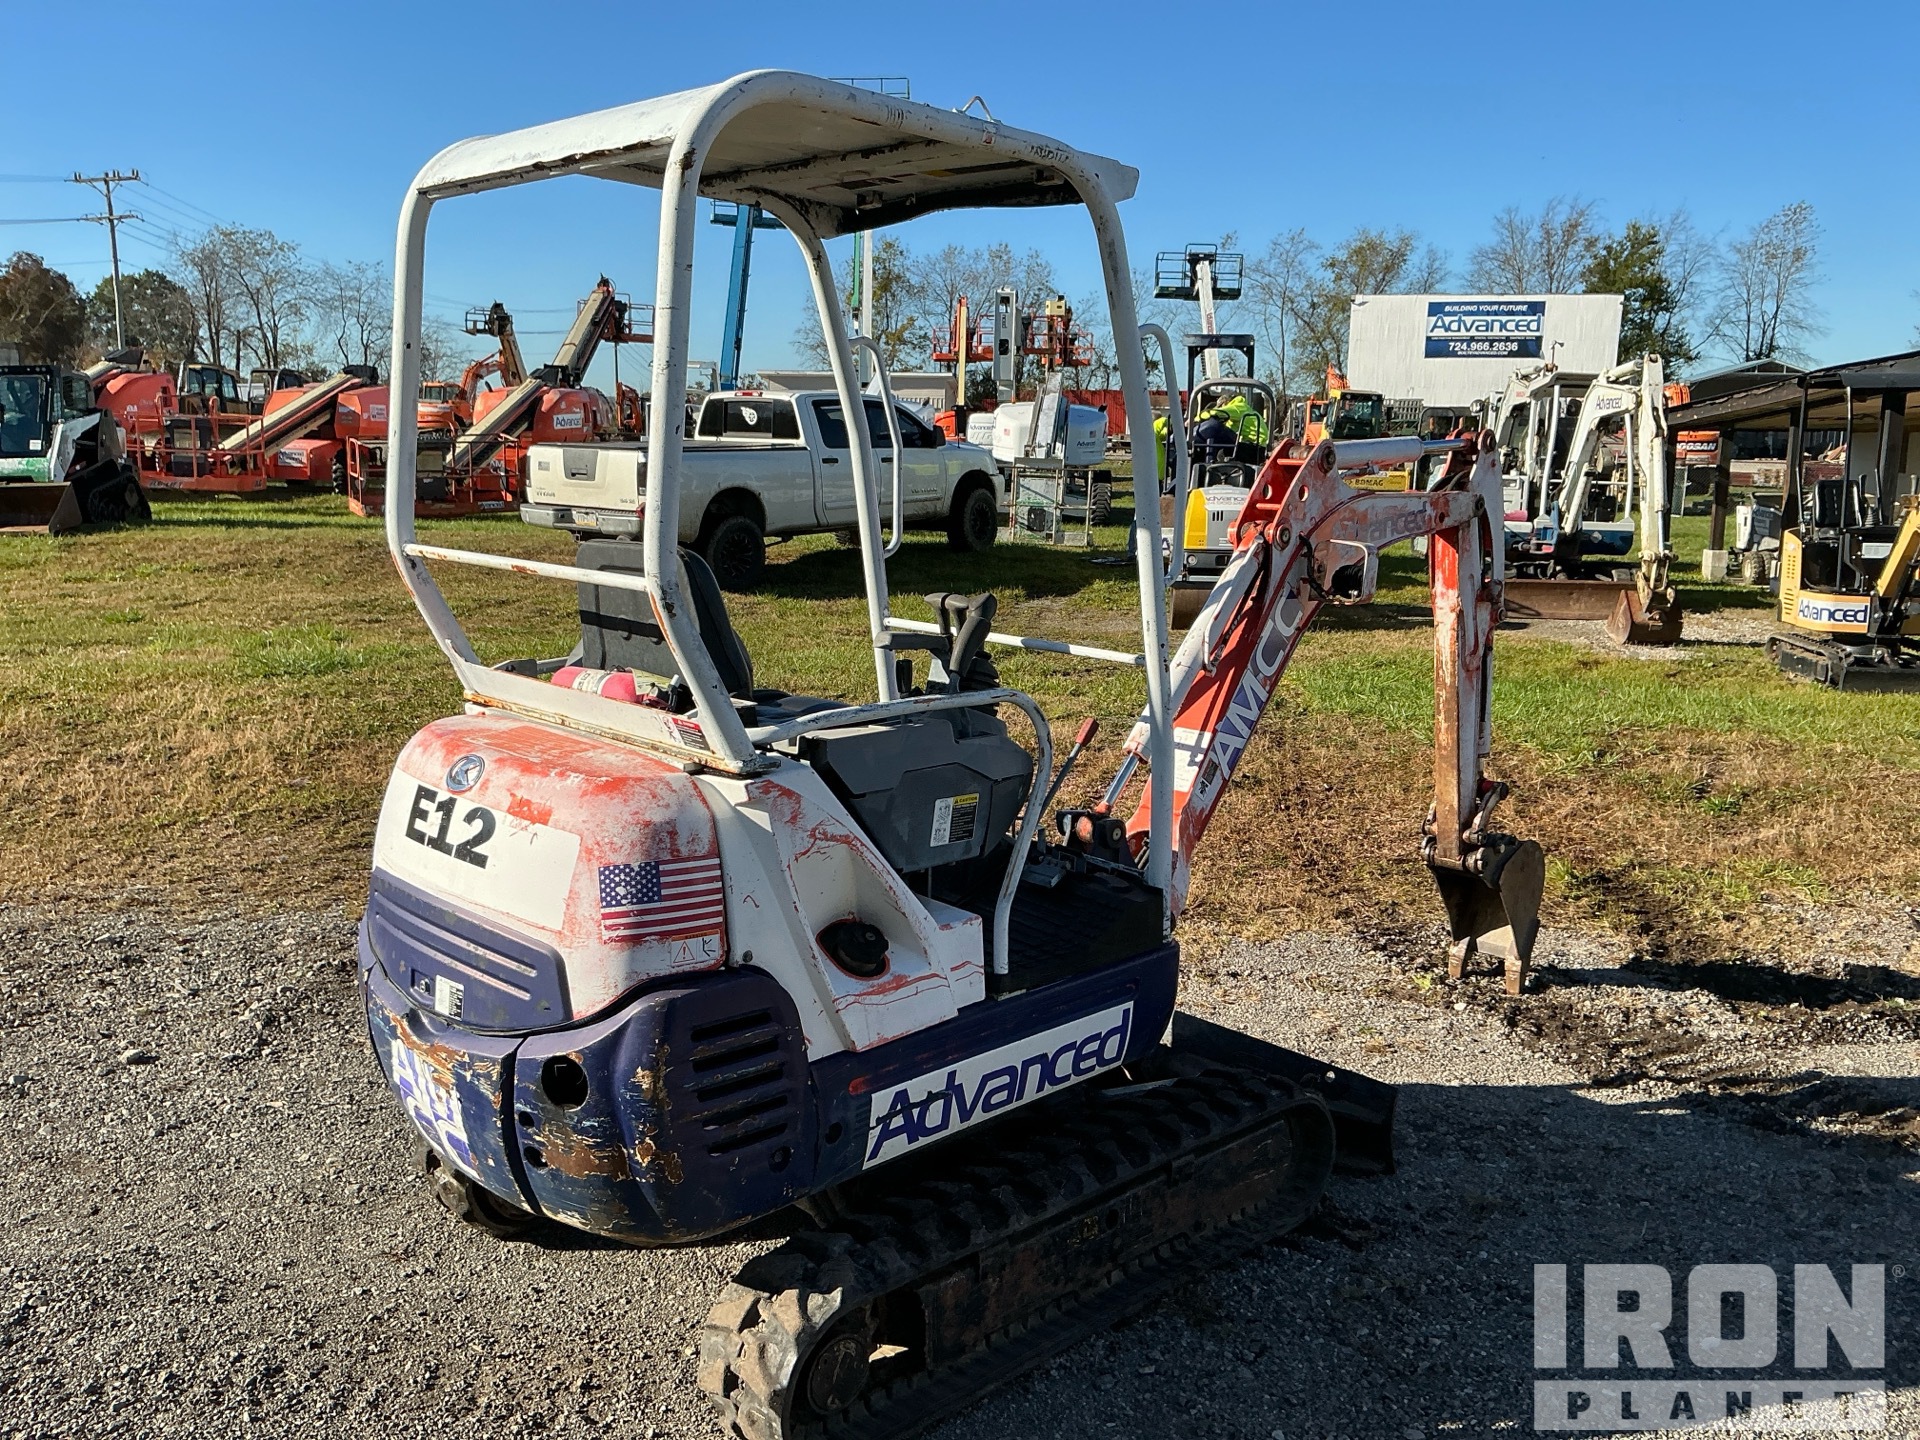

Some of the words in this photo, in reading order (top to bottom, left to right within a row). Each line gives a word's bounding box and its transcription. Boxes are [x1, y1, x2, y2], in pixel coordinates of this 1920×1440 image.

[1444, 304, 1477, 312] BUILDING
[1479, 304, 1498, 312] YOUR
[1499, 304, 1528, 312] FUTURE
[1429, 313, 1541, 333] Advanced
[1448, 342, 1518, 351] 724.966.2636
[1595, 394, 1623, 410] Advanced
[1354, 479, 1384, 487] BOMAG
[1798, 600, 1869, 624] Advanced
[405, 784, 497, 869] E12
[866, 1007, 1131, 1162] Advanced
